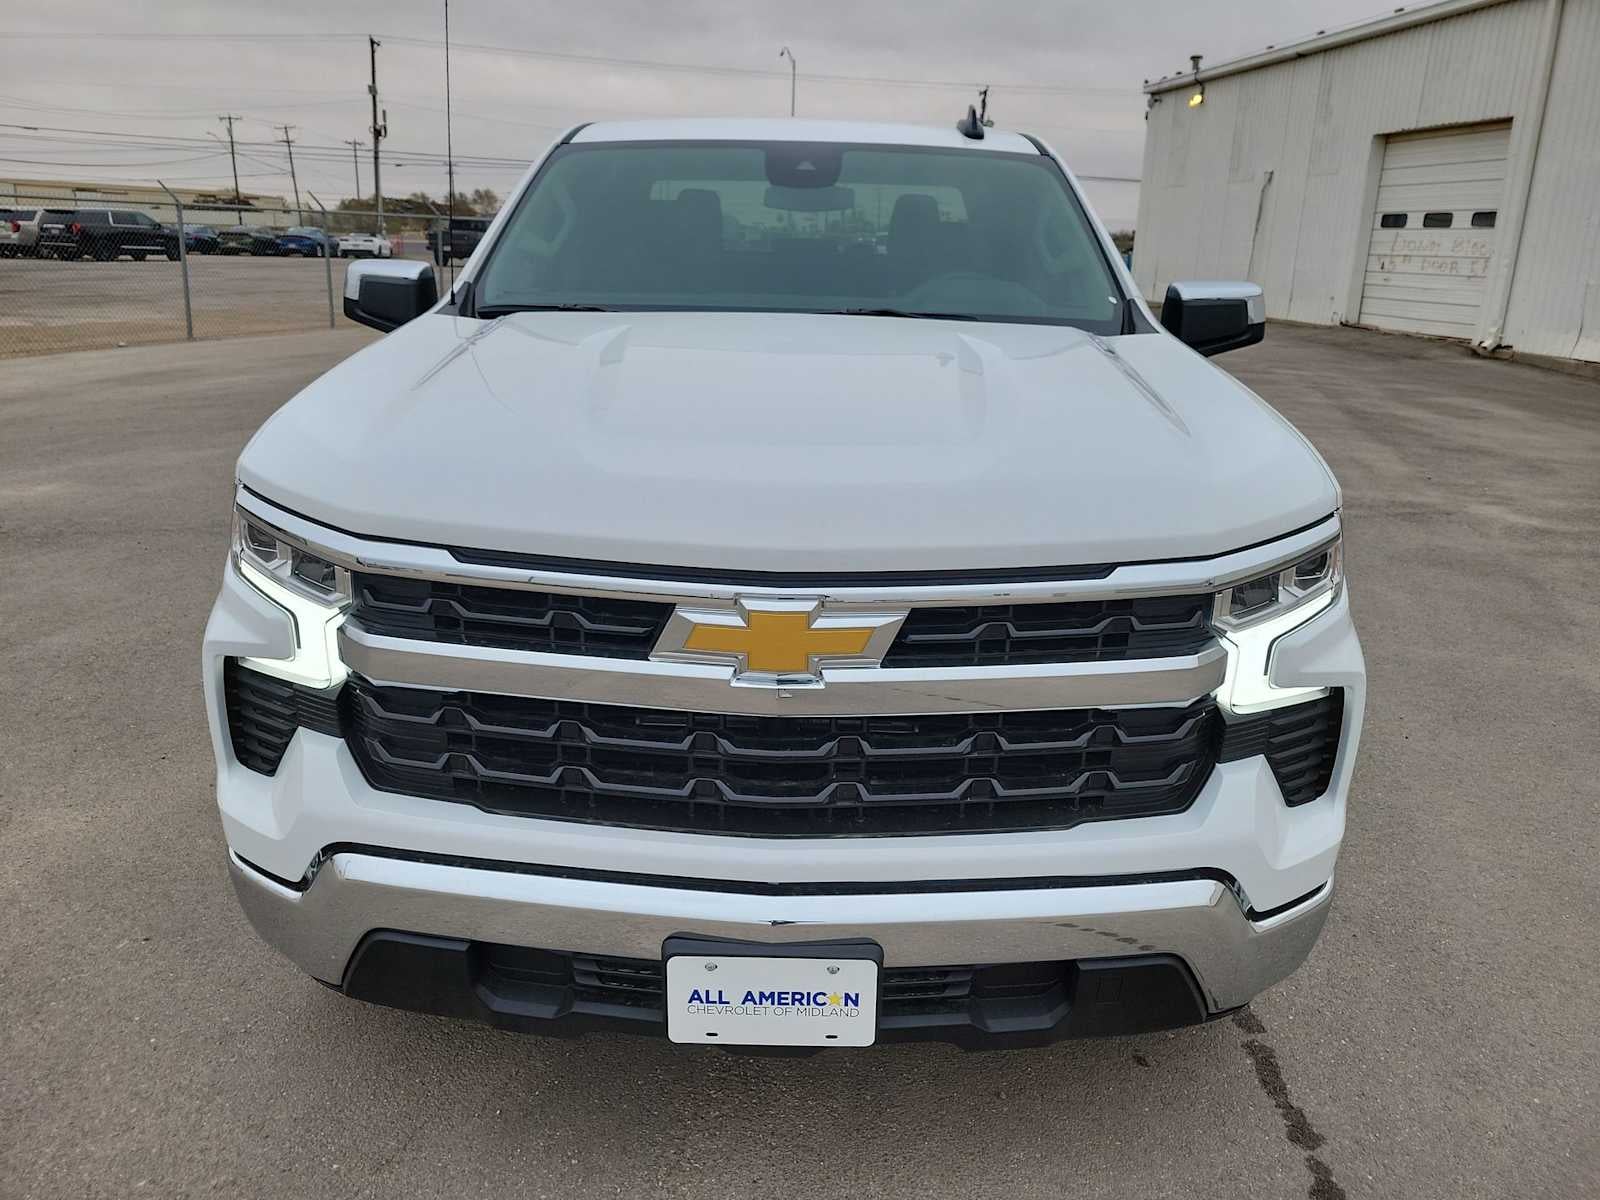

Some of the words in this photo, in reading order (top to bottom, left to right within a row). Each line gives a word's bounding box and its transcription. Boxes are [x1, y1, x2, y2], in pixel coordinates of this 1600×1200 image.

[688, 989, 730, 1004] ALL
[741, 990, 859, 1007] AMERICN
[687, 1004, 769, 1016] CHEVROLET
[773, 1006, 792, 1016] OF
[796, 1007, 860, 1018] MIDLAND
